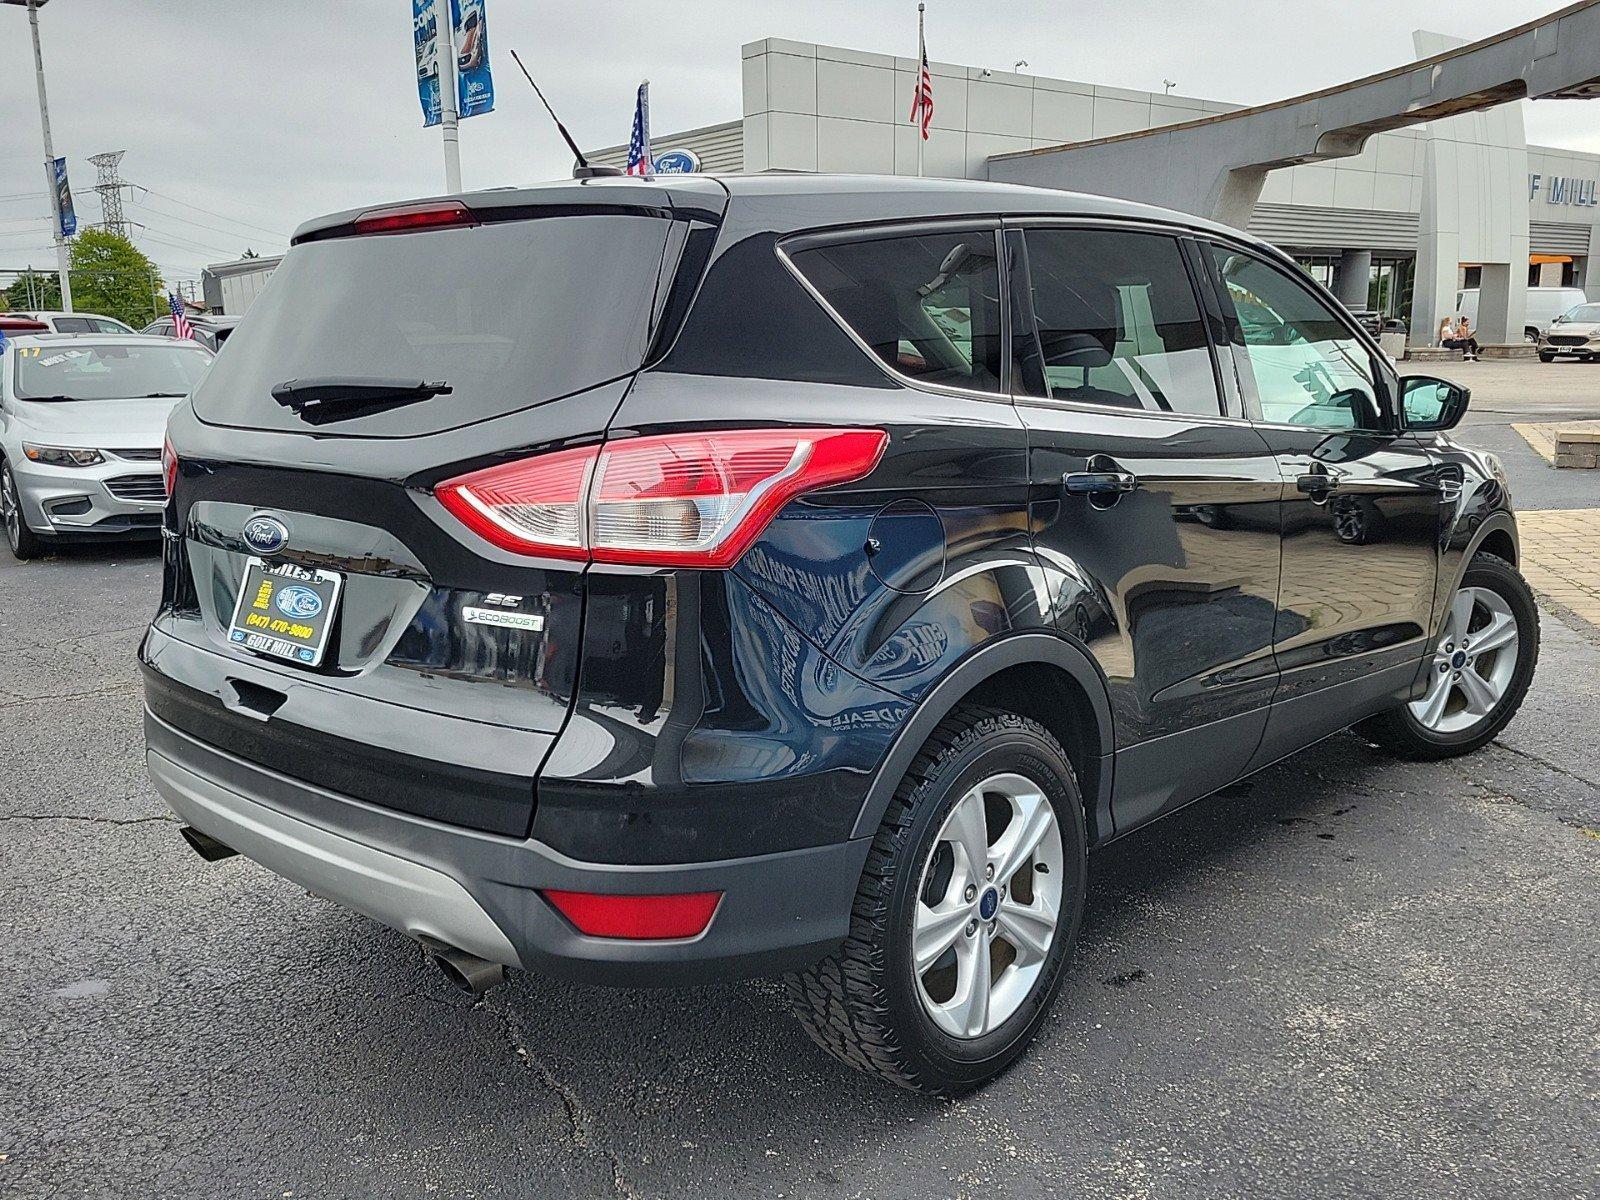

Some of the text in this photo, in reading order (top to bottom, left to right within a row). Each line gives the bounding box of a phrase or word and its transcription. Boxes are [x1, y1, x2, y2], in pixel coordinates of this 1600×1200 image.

[658, 157, 685, 174] Ford
[1548, 176, 1598, 207] MILL
[249, 523, 275, 544] Ford
[299, 596, 317, 610] Ford
[484, 592, 523, 608] SE
[246, 612, 270, 629] (847)
[478, 612, 538, 627] ECOBOOST
[246, 634, 273, 650] GOLF
[270, 640, 297, 658] MILL
